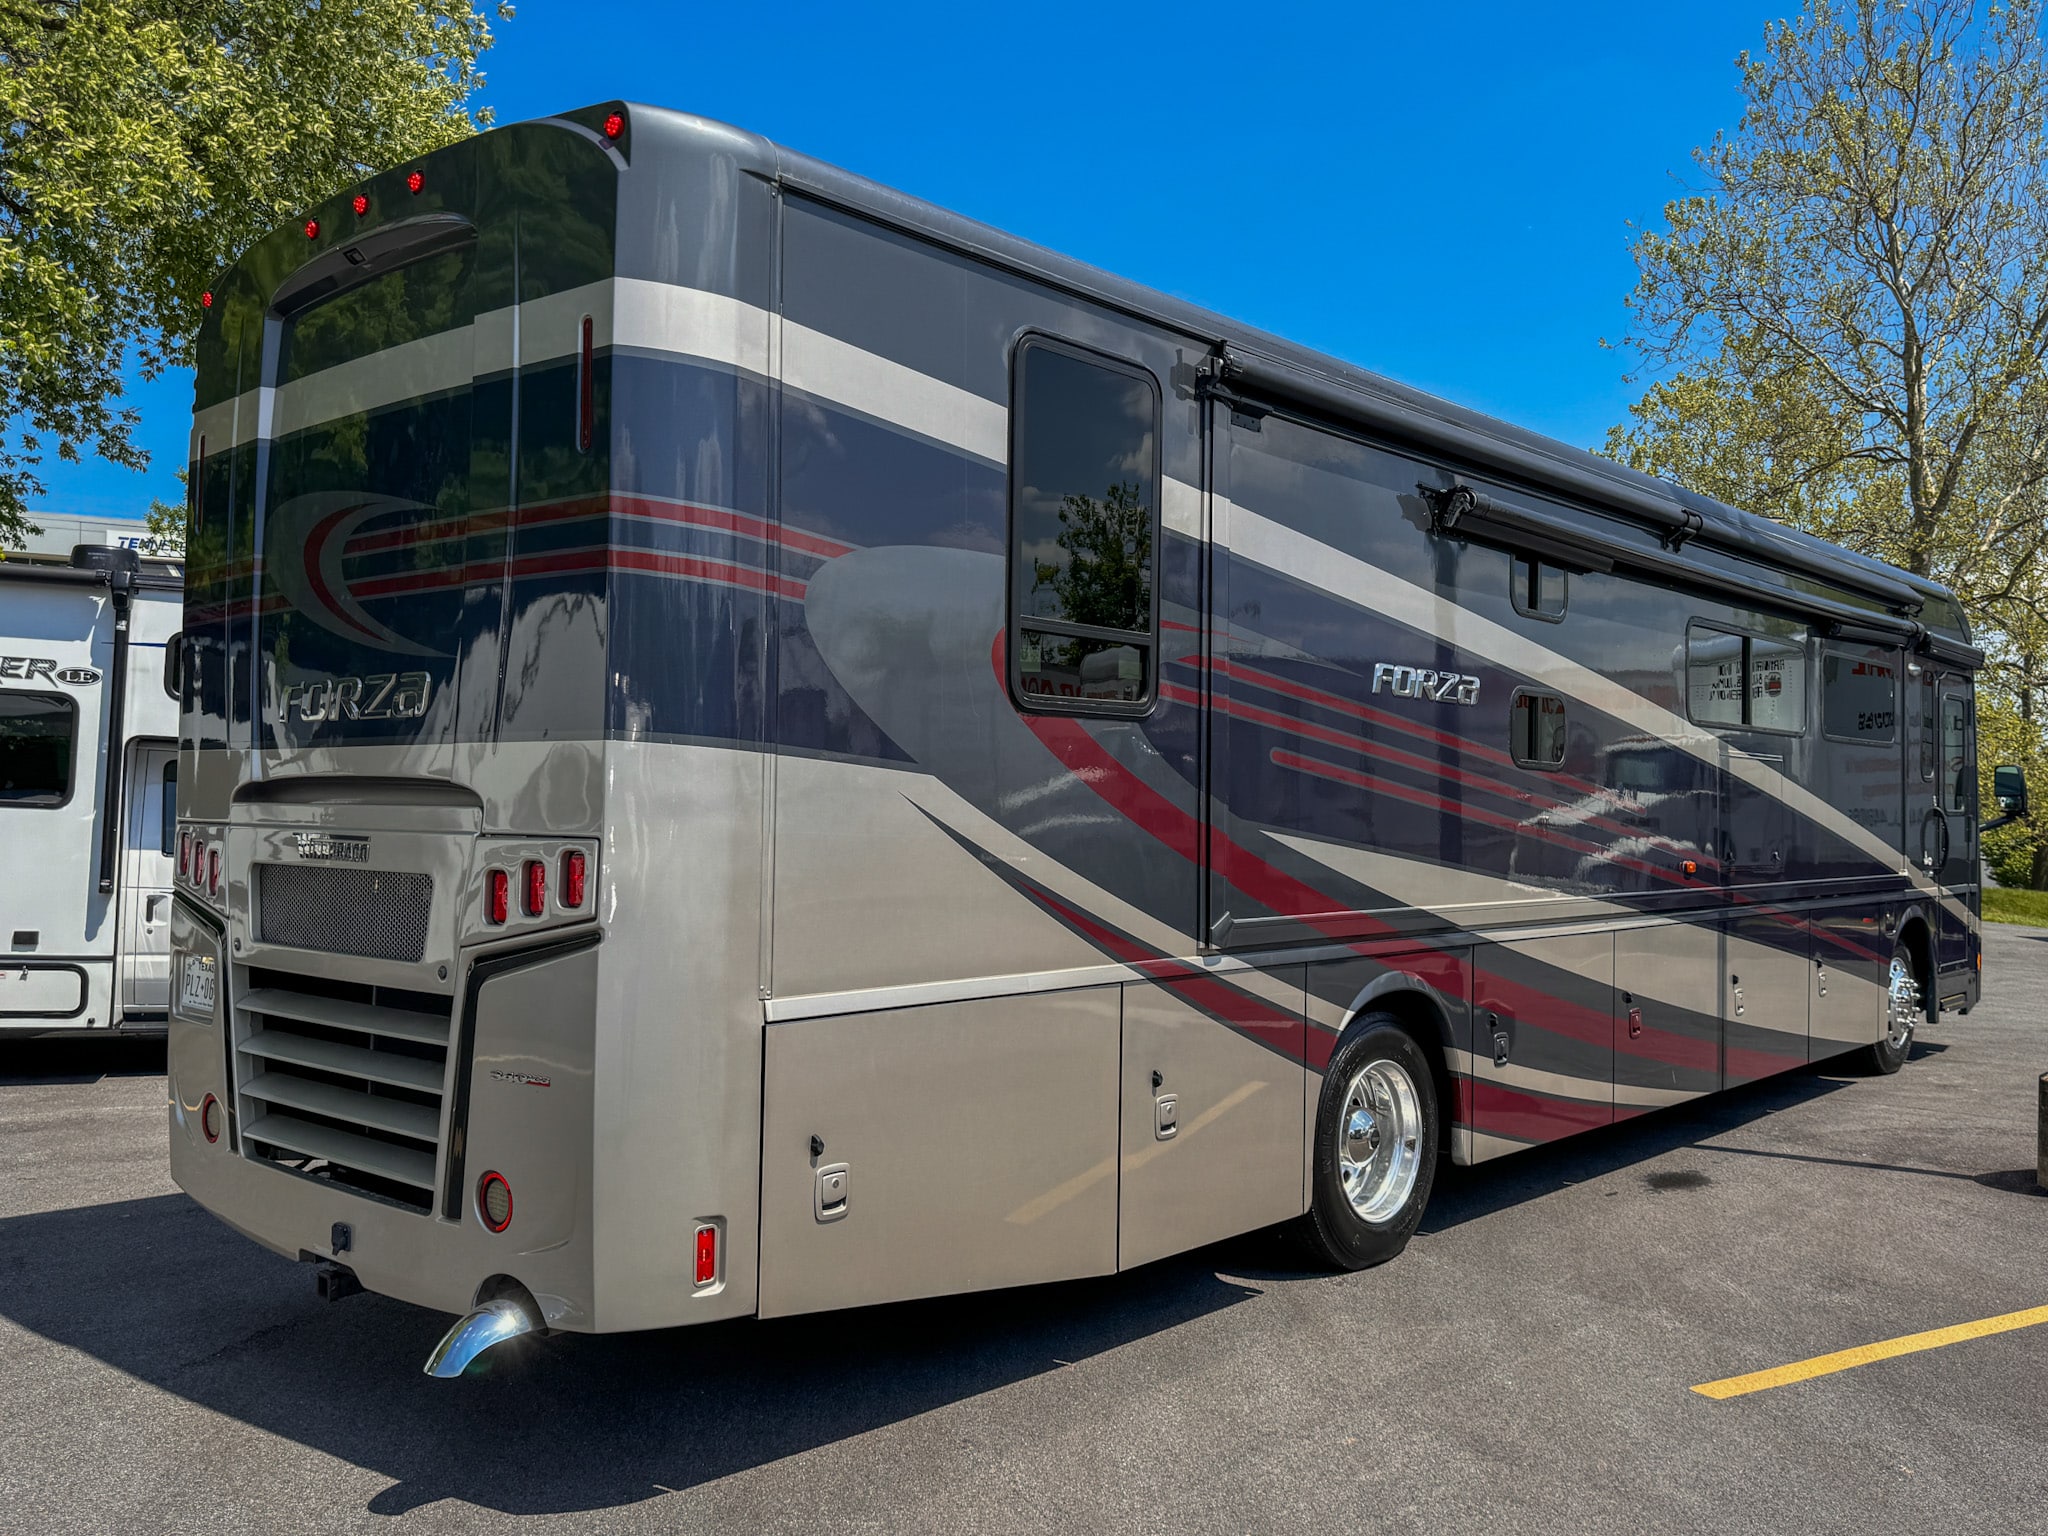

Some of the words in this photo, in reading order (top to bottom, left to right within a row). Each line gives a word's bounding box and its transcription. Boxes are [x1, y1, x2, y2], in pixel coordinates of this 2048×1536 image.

[0, 656, 58, 688] ER
[65, 670, 94, 683] LE
[1371, 662, 1480, 706] FORZA
[279, 671, 432, 723] FORZA
[198, 961, 216, 973] TEXAS
